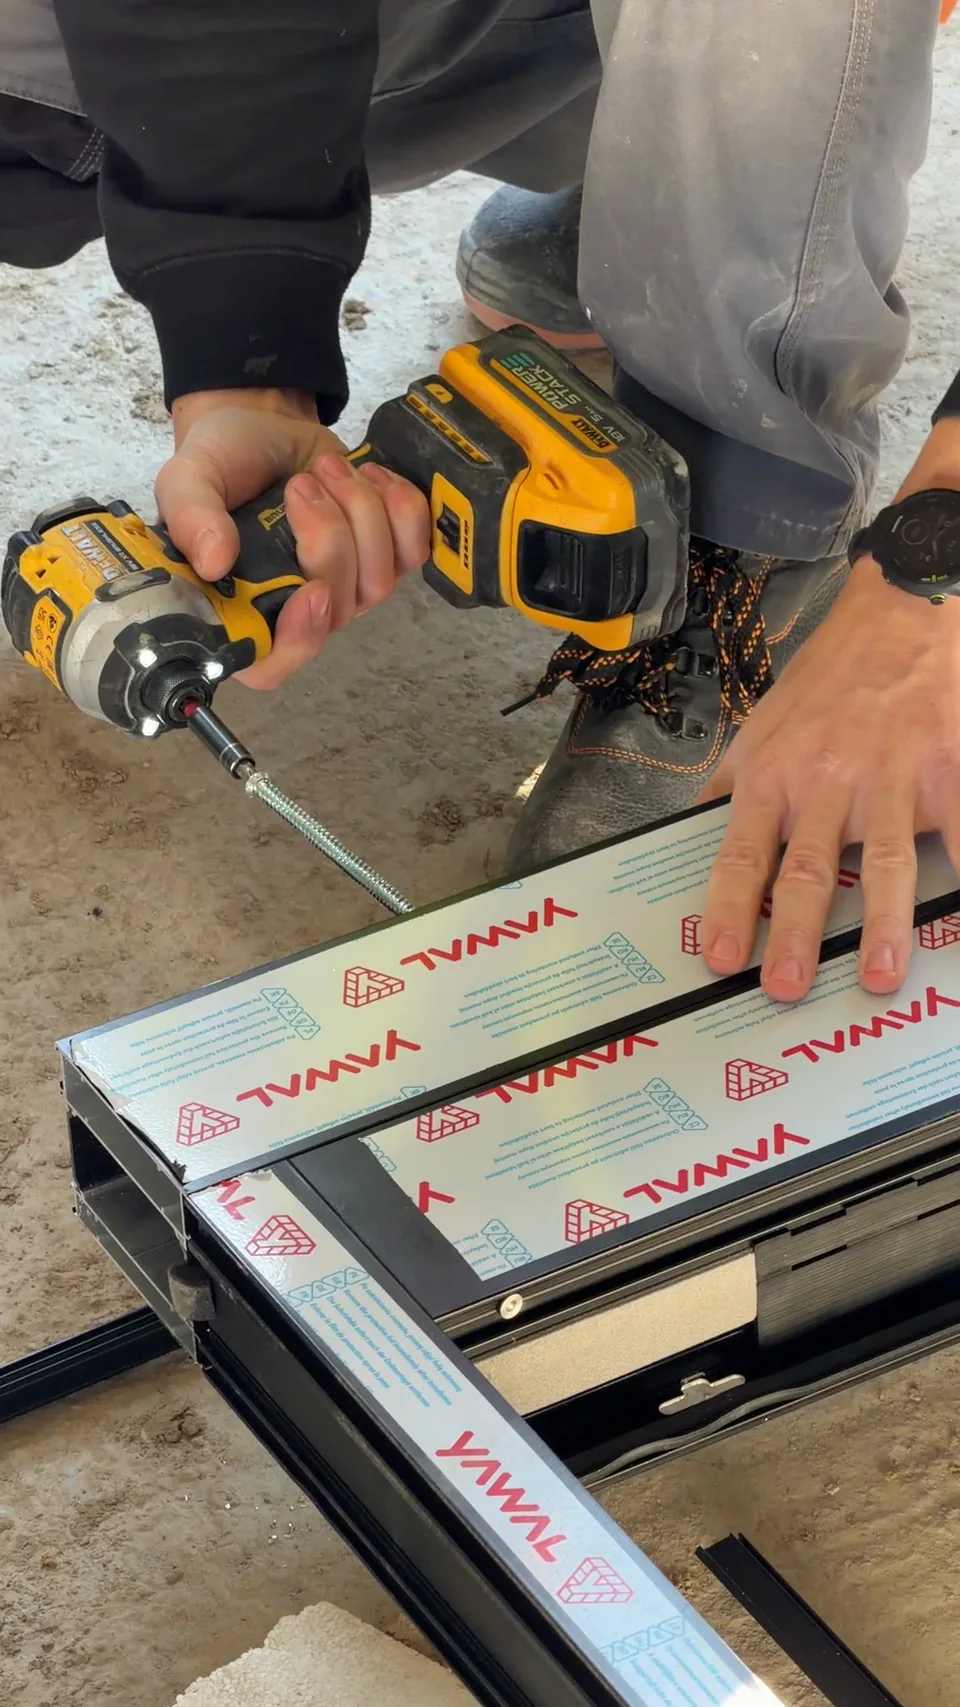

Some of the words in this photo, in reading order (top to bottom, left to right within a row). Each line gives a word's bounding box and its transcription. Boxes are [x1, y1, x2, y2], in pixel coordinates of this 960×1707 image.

[512, 365, 569, 410] POWER
[530, 364, 582, 405] STACK
[602, 425, 626, 442] 18V
[401, 898, 577, 972] YAWAL
[782, 987, 960, 1065] YAWAL
[237, 1031, 421, 1108] YAWAL
[478, 1037, 660, 1105] YAWAL
[624, 1124, 811, 1206] YAWAL
[436, 1431, 565, 1563] YAWAL
